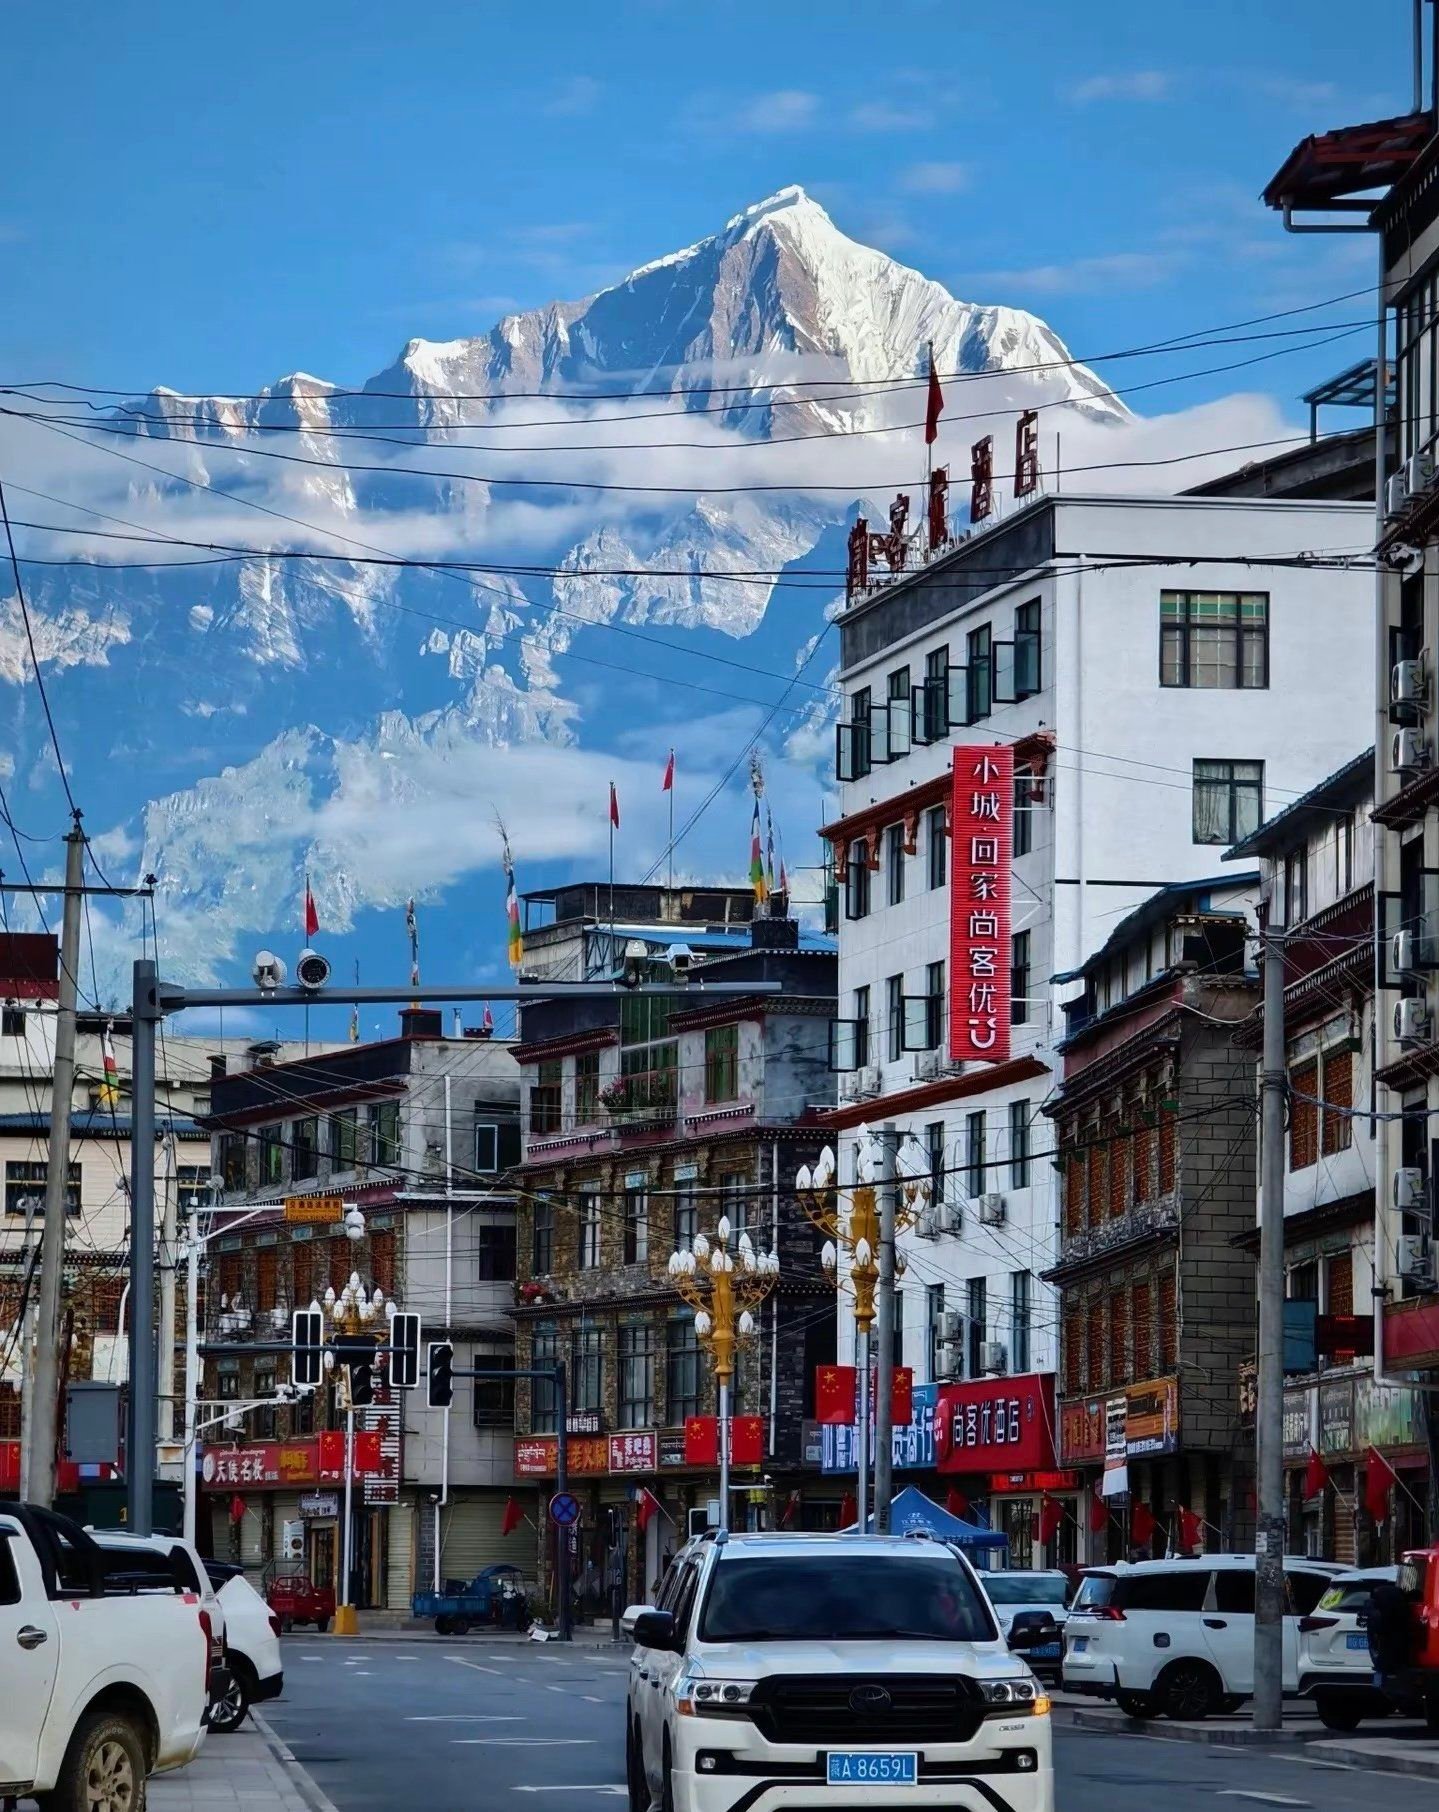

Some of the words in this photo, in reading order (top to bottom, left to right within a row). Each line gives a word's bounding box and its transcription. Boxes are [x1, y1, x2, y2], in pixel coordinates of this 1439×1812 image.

[952, 1396, 1020, 1448] 尚客优酒店
